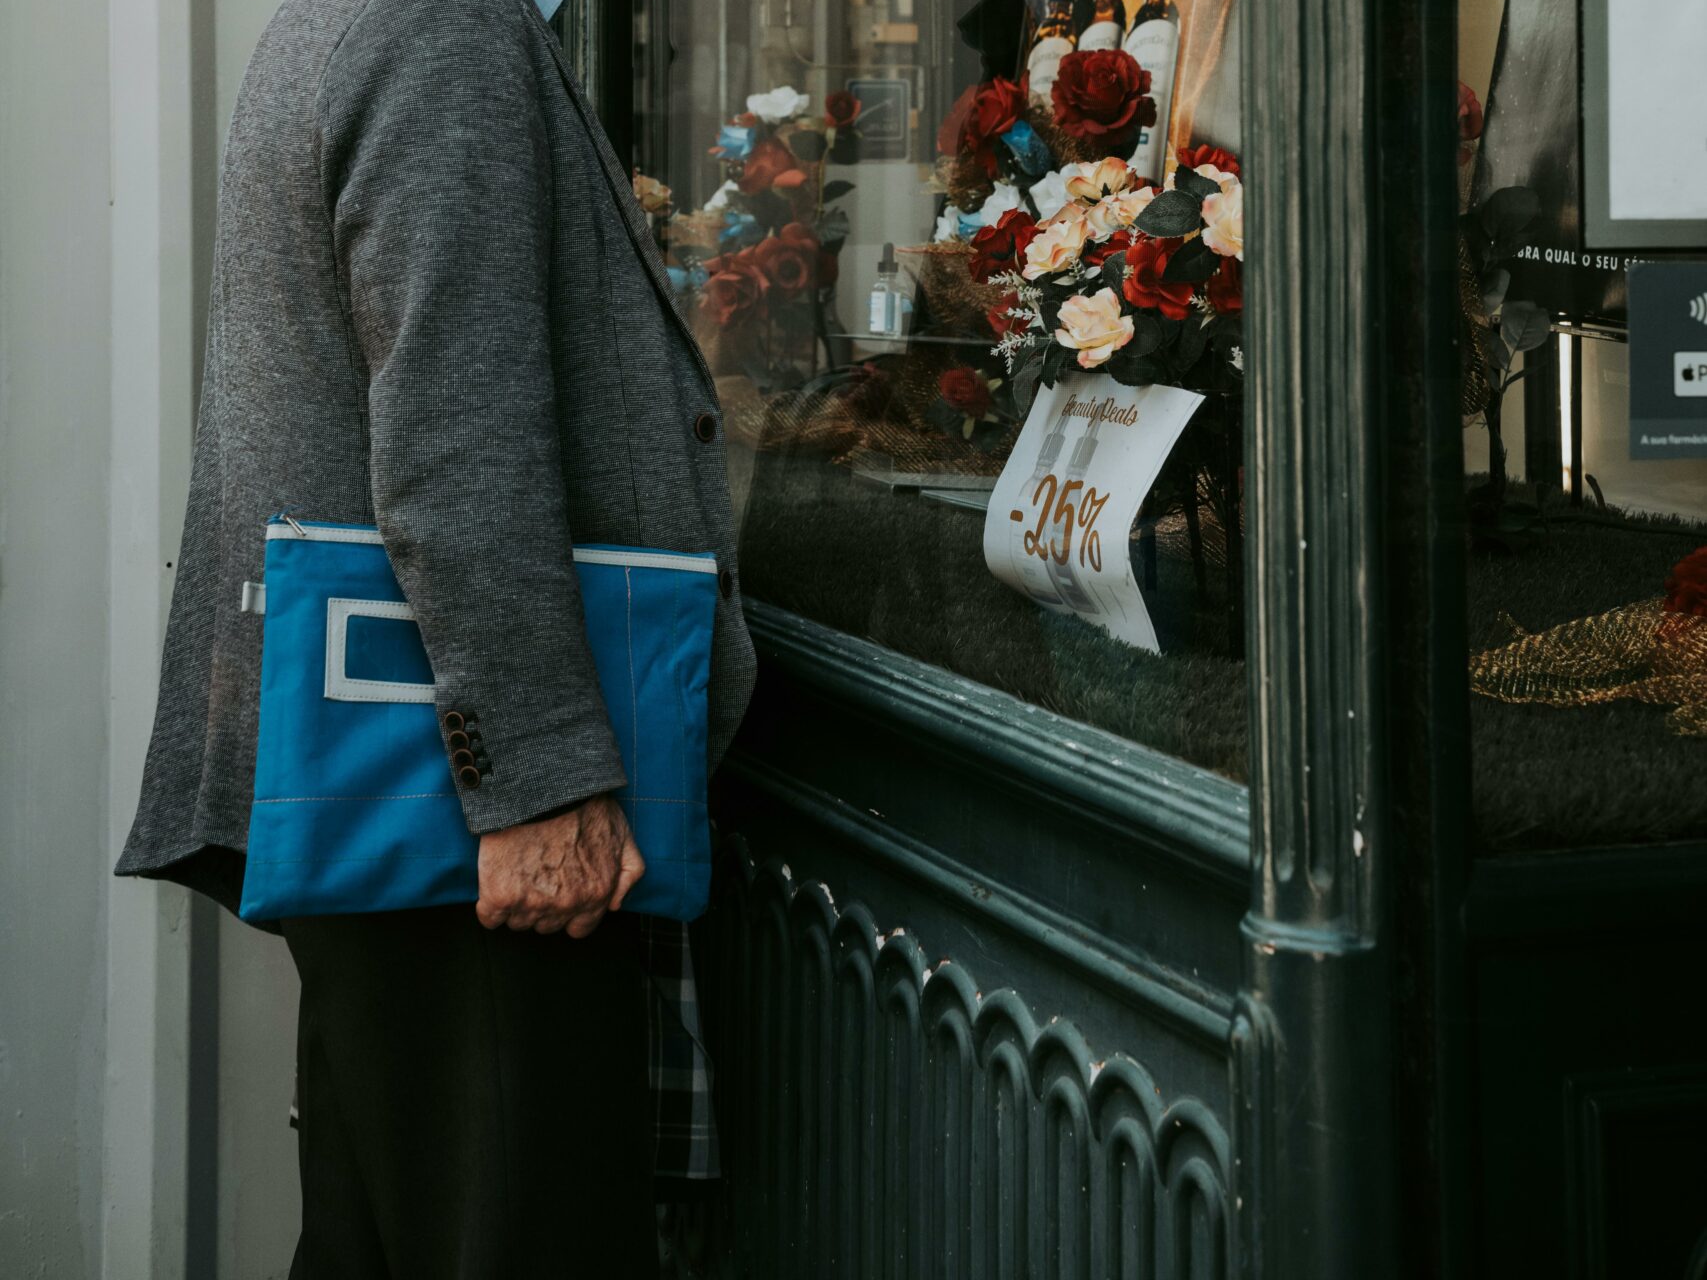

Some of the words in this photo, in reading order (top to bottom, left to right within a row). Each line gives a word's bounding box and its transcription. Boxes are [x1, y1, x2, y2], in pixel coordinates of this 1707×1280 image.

[1512, 245, 1540, 261] BRA
[1545, 248, 1578, 265] QUAL
[1582, 254, 1591, 267] O
[1595, 255, 1618, 271] SEU
